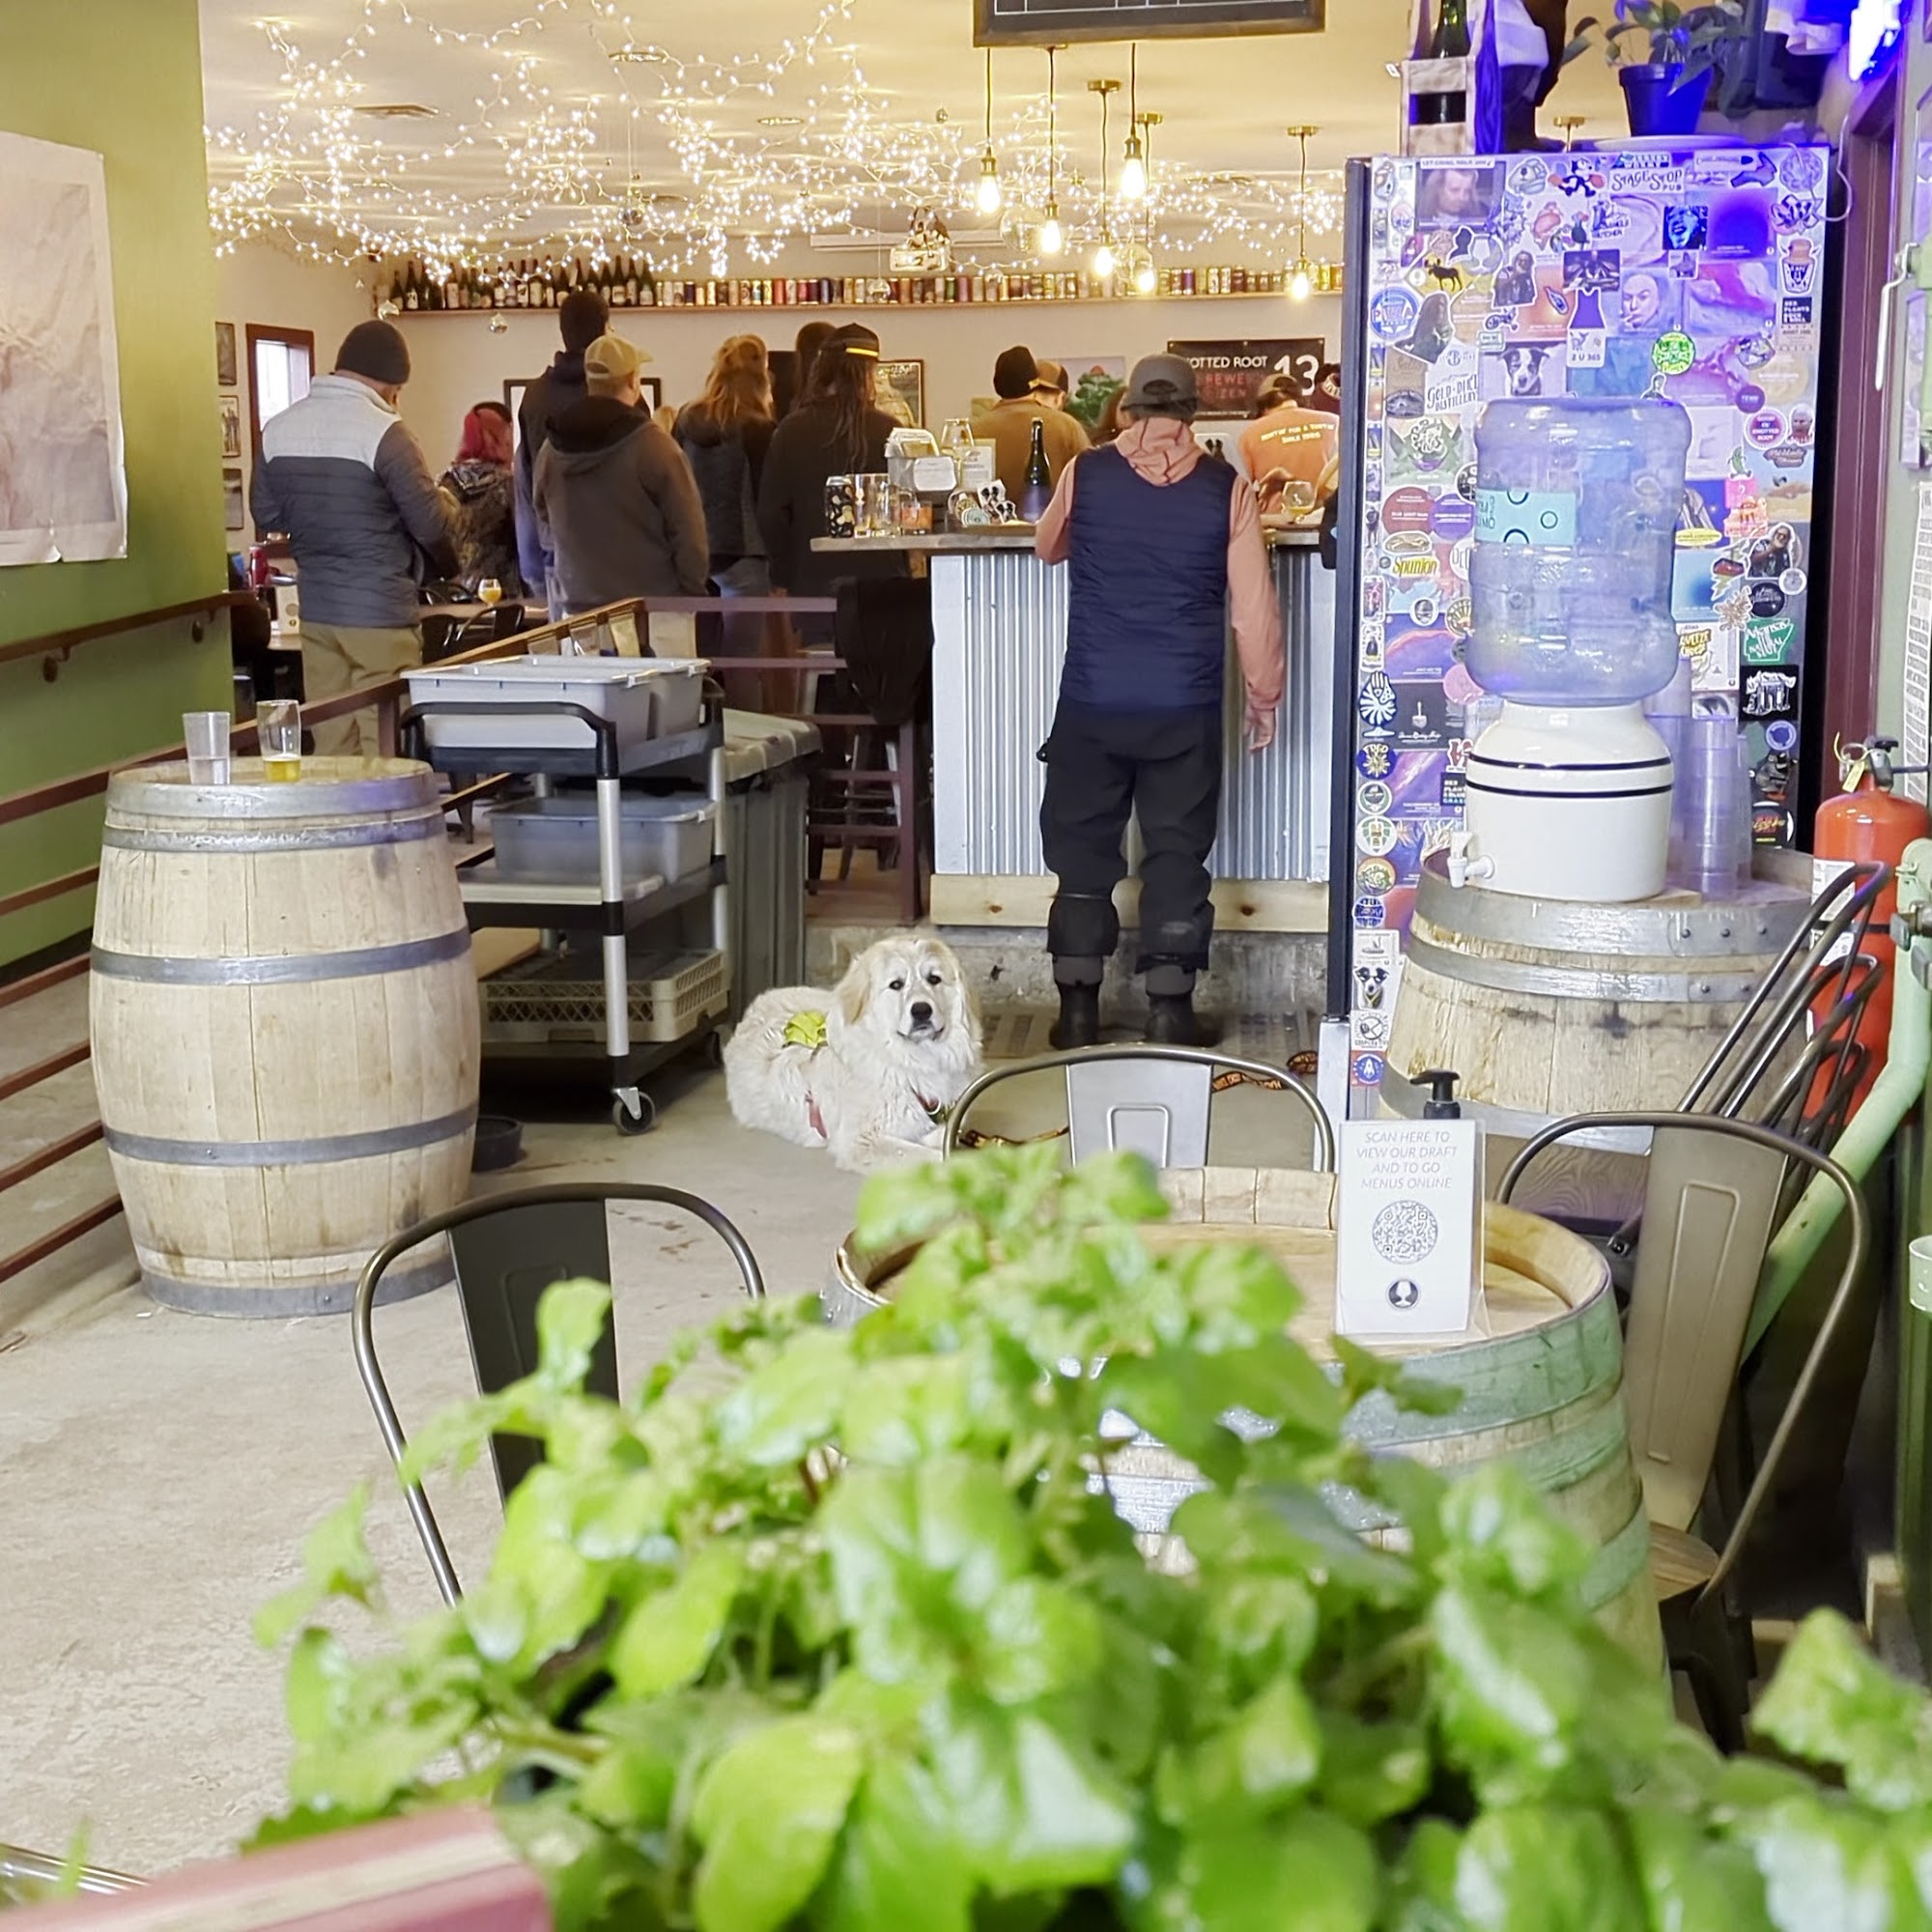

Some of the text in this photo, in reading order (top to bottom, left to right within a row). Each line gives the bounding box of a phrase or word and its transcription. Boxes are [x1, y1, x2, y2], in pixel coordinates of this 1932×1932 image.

[1187, 356, 1231, 368] OTTED
[1234, 355, 1268, 368] ROOT
[1365, 1131, 1450, 1144] SCAN HERE TO
[1357, 1147, 1458, 1158] VIEW OUR DRAFT
[1373, 1162, 1440, 1174] AND TO GO
[1361, 1177, 1452, 1189] MENUS ONLINE
